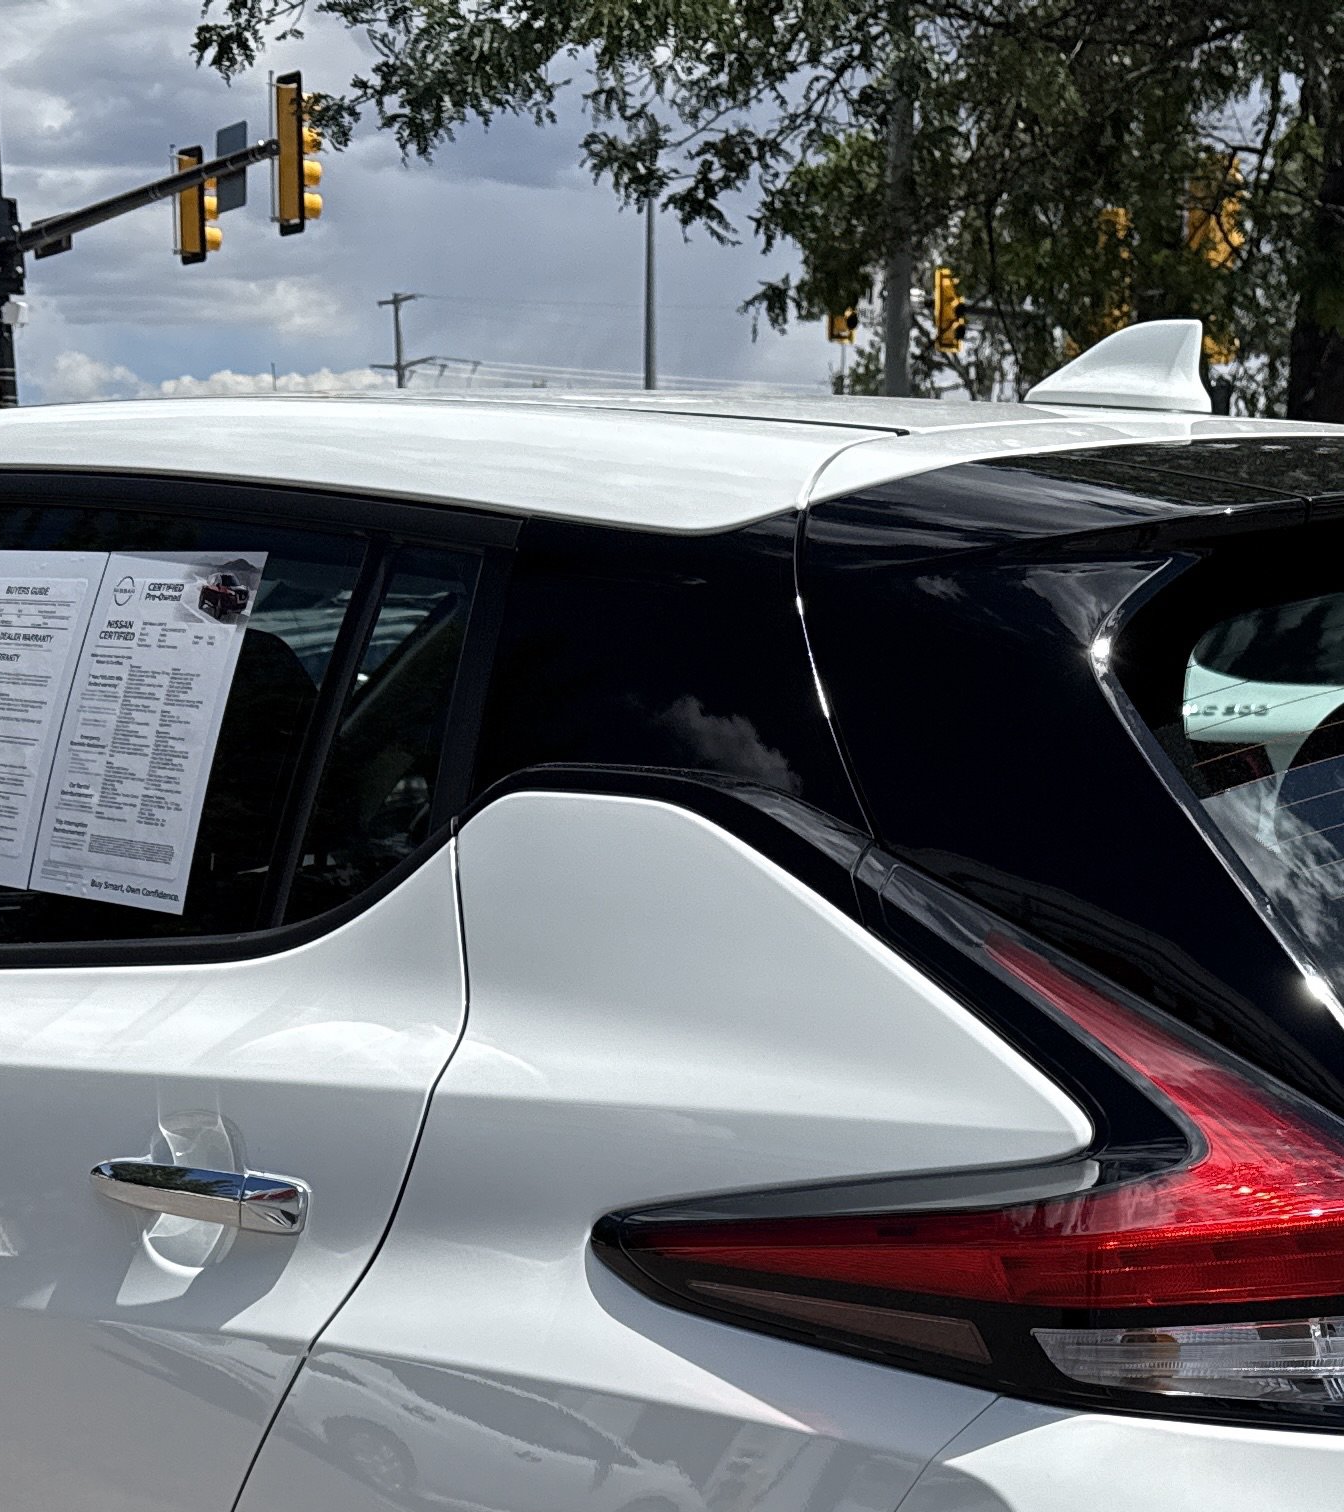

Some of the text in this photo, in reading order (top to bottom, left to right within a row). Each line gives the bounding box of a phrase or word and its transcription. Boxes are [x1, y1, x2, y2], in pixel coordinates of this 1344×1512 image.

[30, 586, 50, 596] GUIDE
[147, 582, 184, 592] CERTIFIED
[145, 592, 182, 602] Pre-Owned
[106, 620, 134, 629] NISSAN
[99, 631, 135, 641] CERTIFIED
